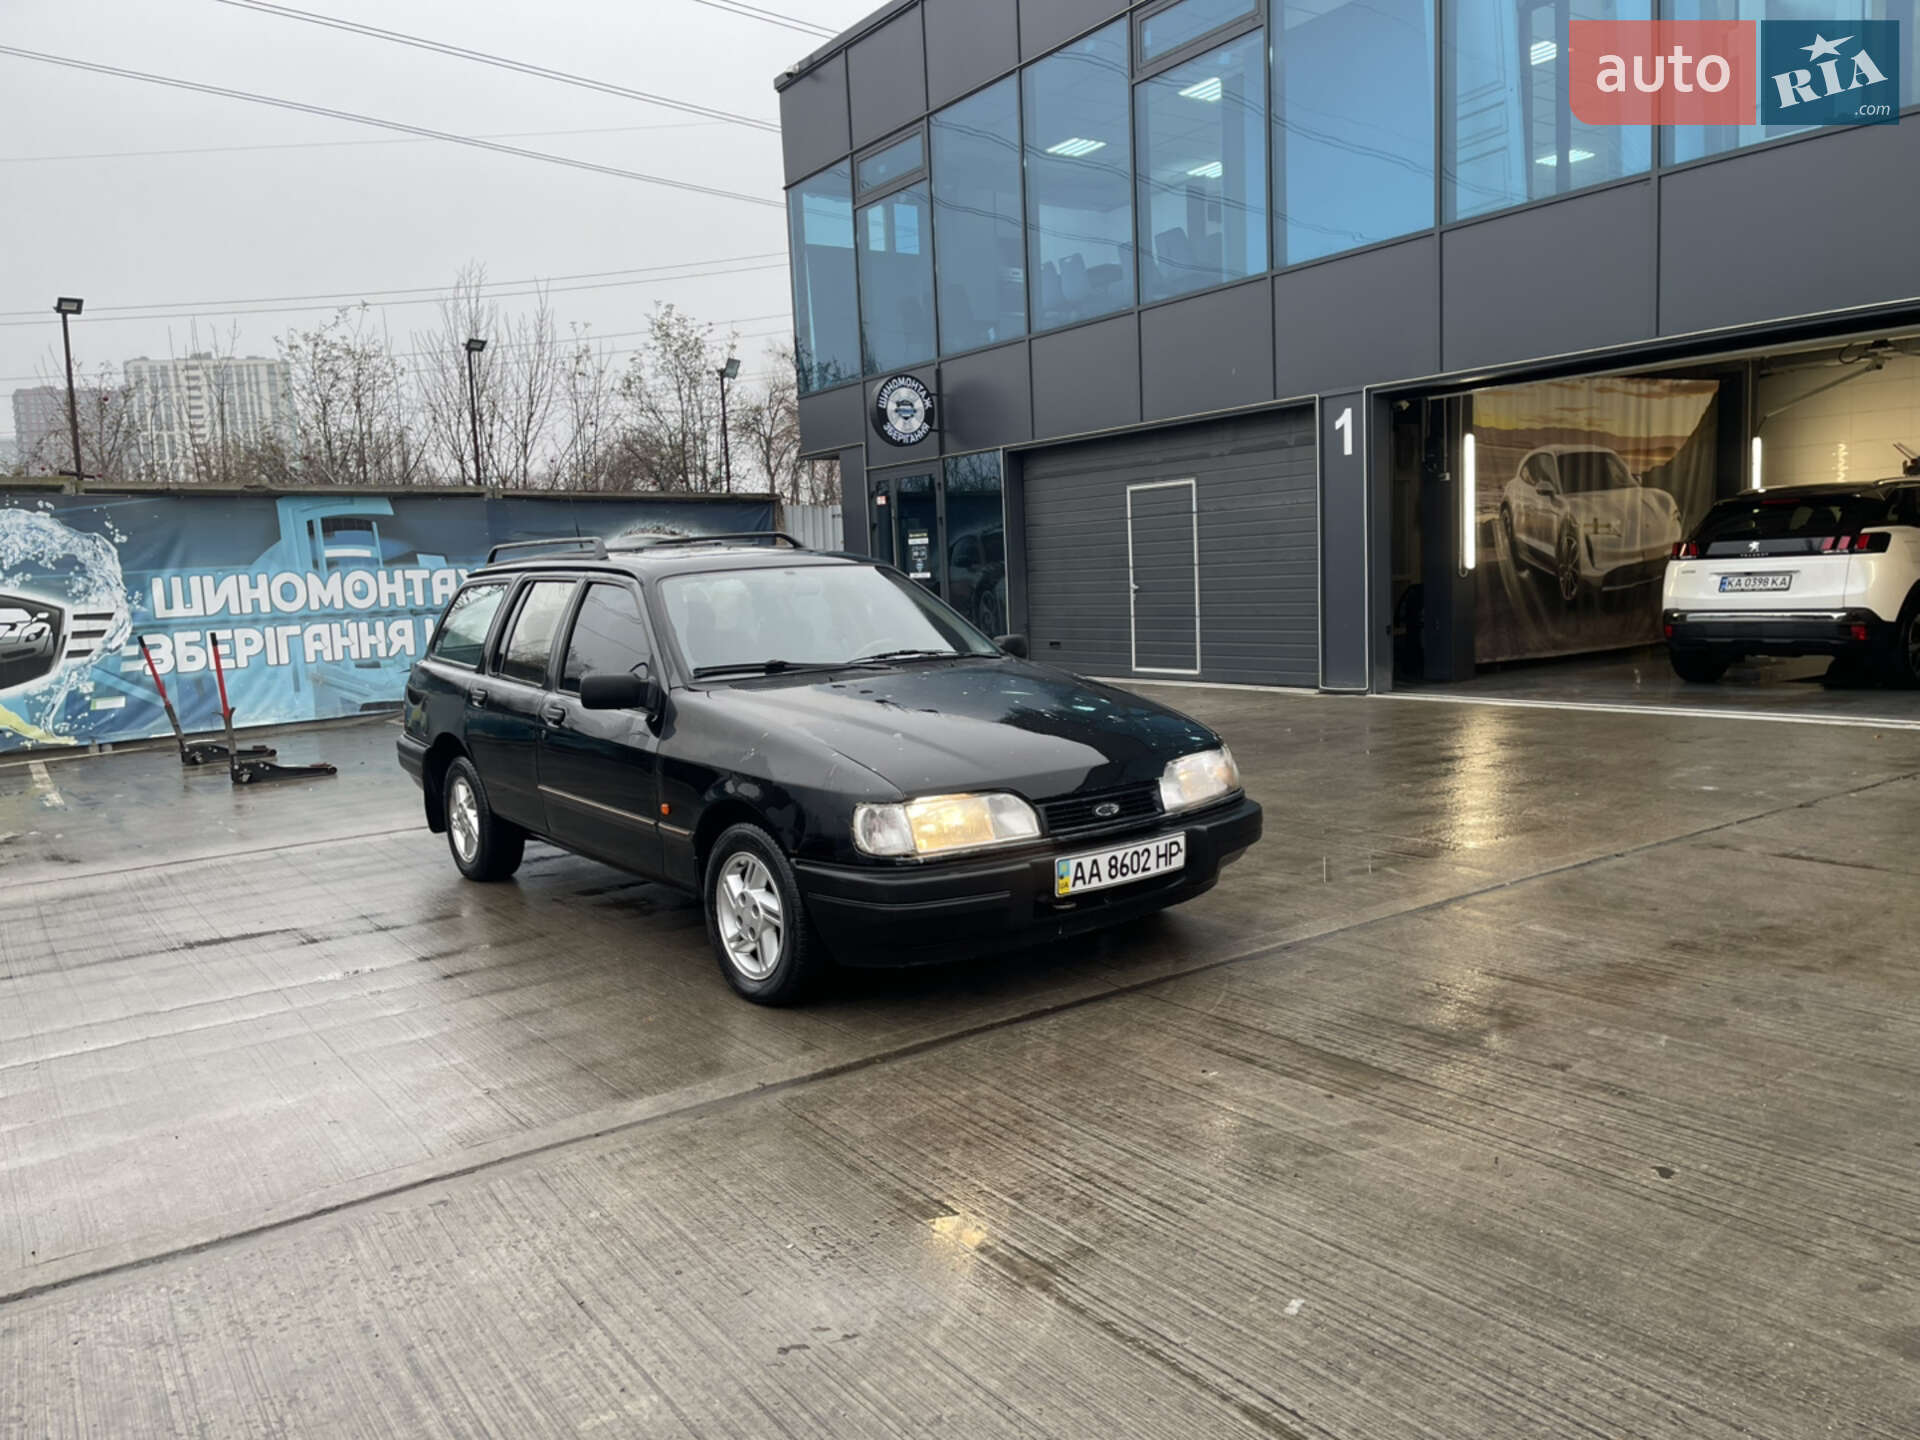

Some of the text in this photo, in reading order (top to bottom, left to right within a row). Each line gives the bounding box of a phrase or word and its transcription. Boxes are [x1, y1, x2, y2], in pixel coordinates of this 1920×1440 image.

[878, 376, 933, 410] ШИНОМОНТАЖ
[1335, 407, 1352, 455] 1
[1727, 578, 1742, 588] KA
[1771, 577, 1787, 586] KA
[143, 619, 415, 675] ЗБЕРІГАННЯ
[1072, 841, 1182, 887] AA 8602 HP
